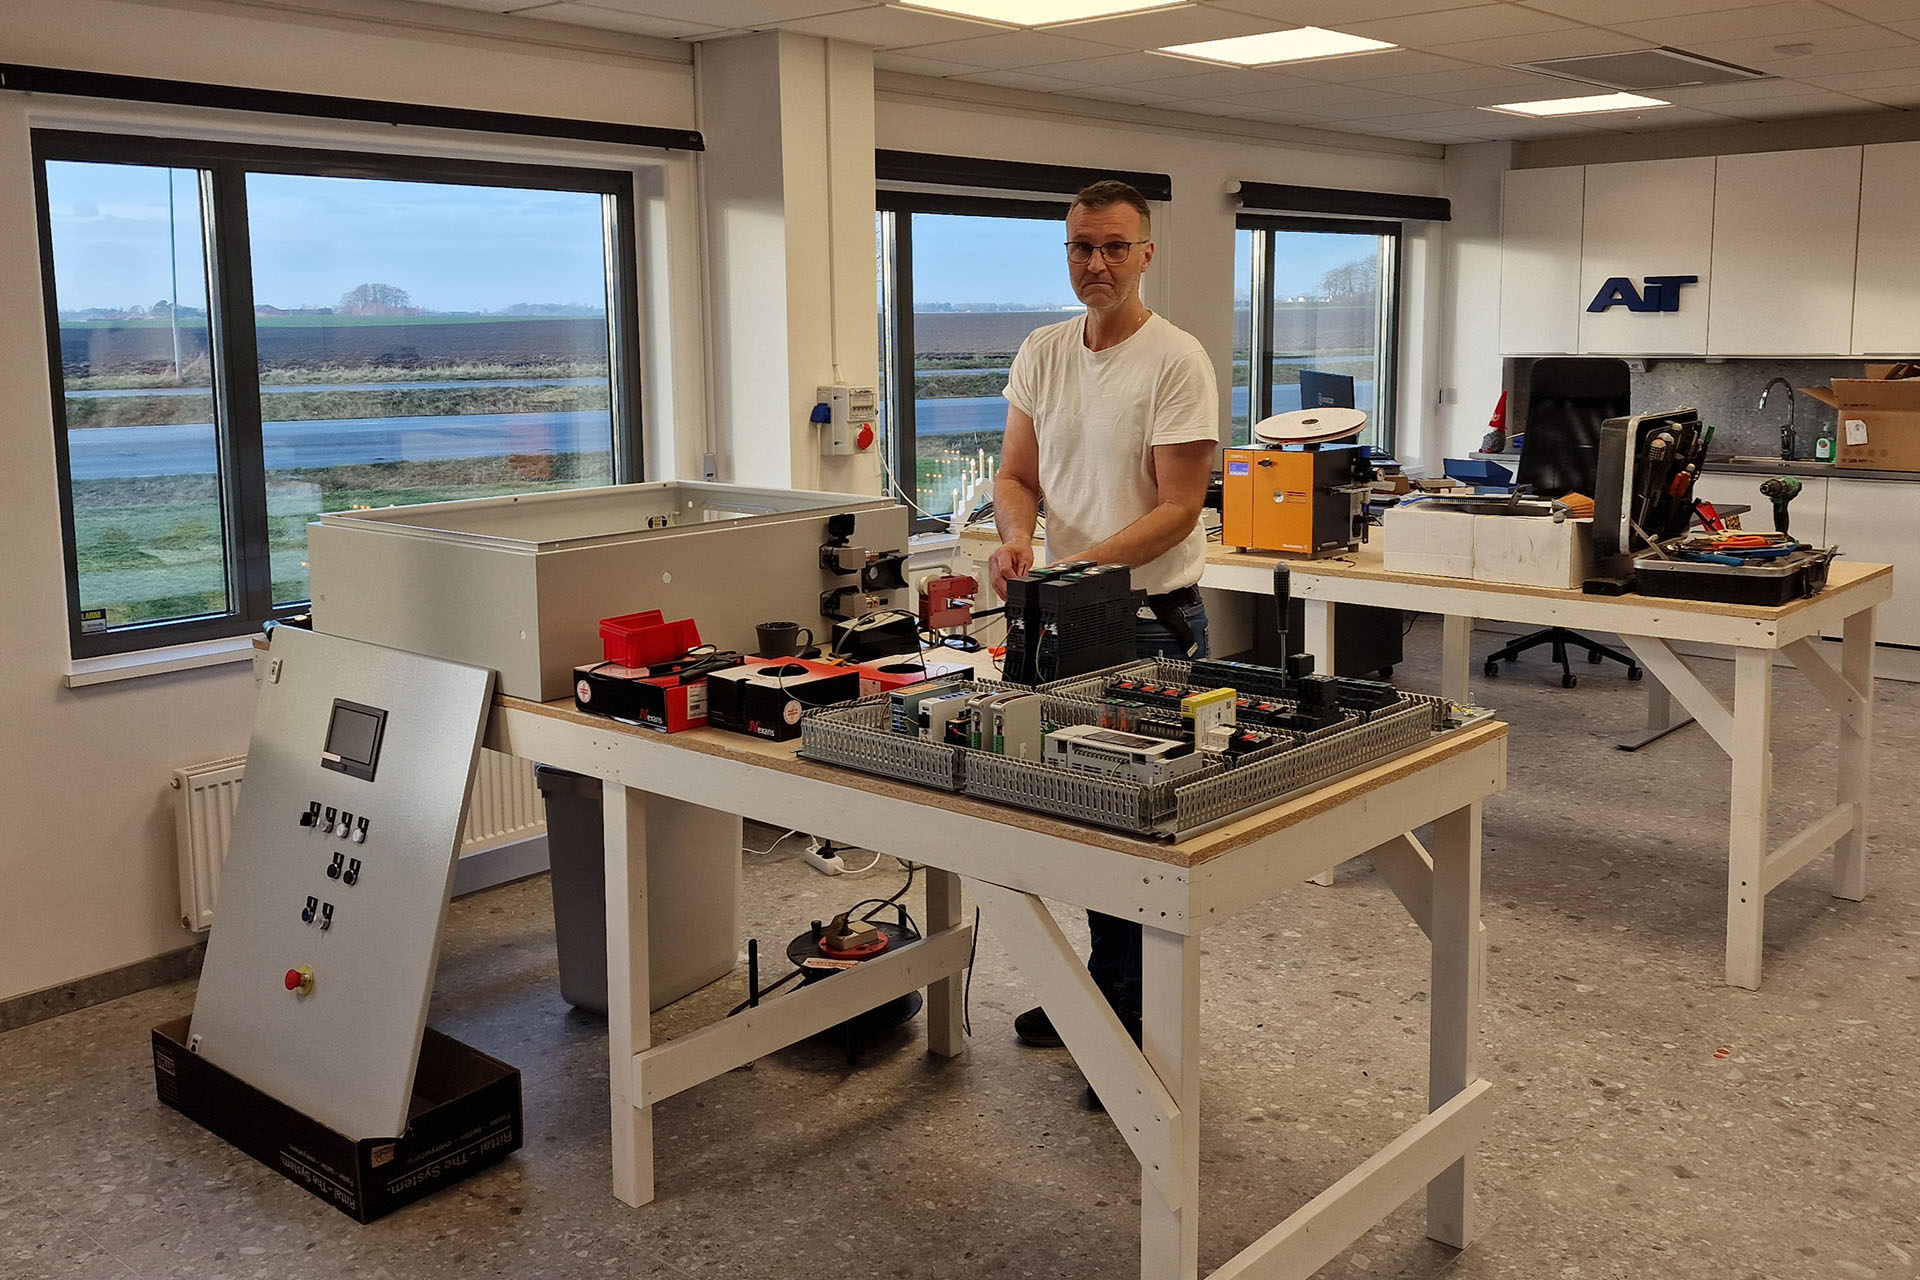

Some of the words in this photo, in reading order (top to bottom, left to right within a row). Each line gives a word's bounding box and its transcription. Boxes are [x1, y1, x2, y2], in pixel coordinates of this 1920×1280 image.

[639, 708, 663, 724] Nexans
[747, 720, 775, 736] Nexans
[480, 1130, 512, 1155] Rittal
[444, 1155, 468, 1168] The
[313, 1175, 328, 1193] The
[387, 1166, 440, 1194] System.
[334, 1187, 356, 1210] Rittal
